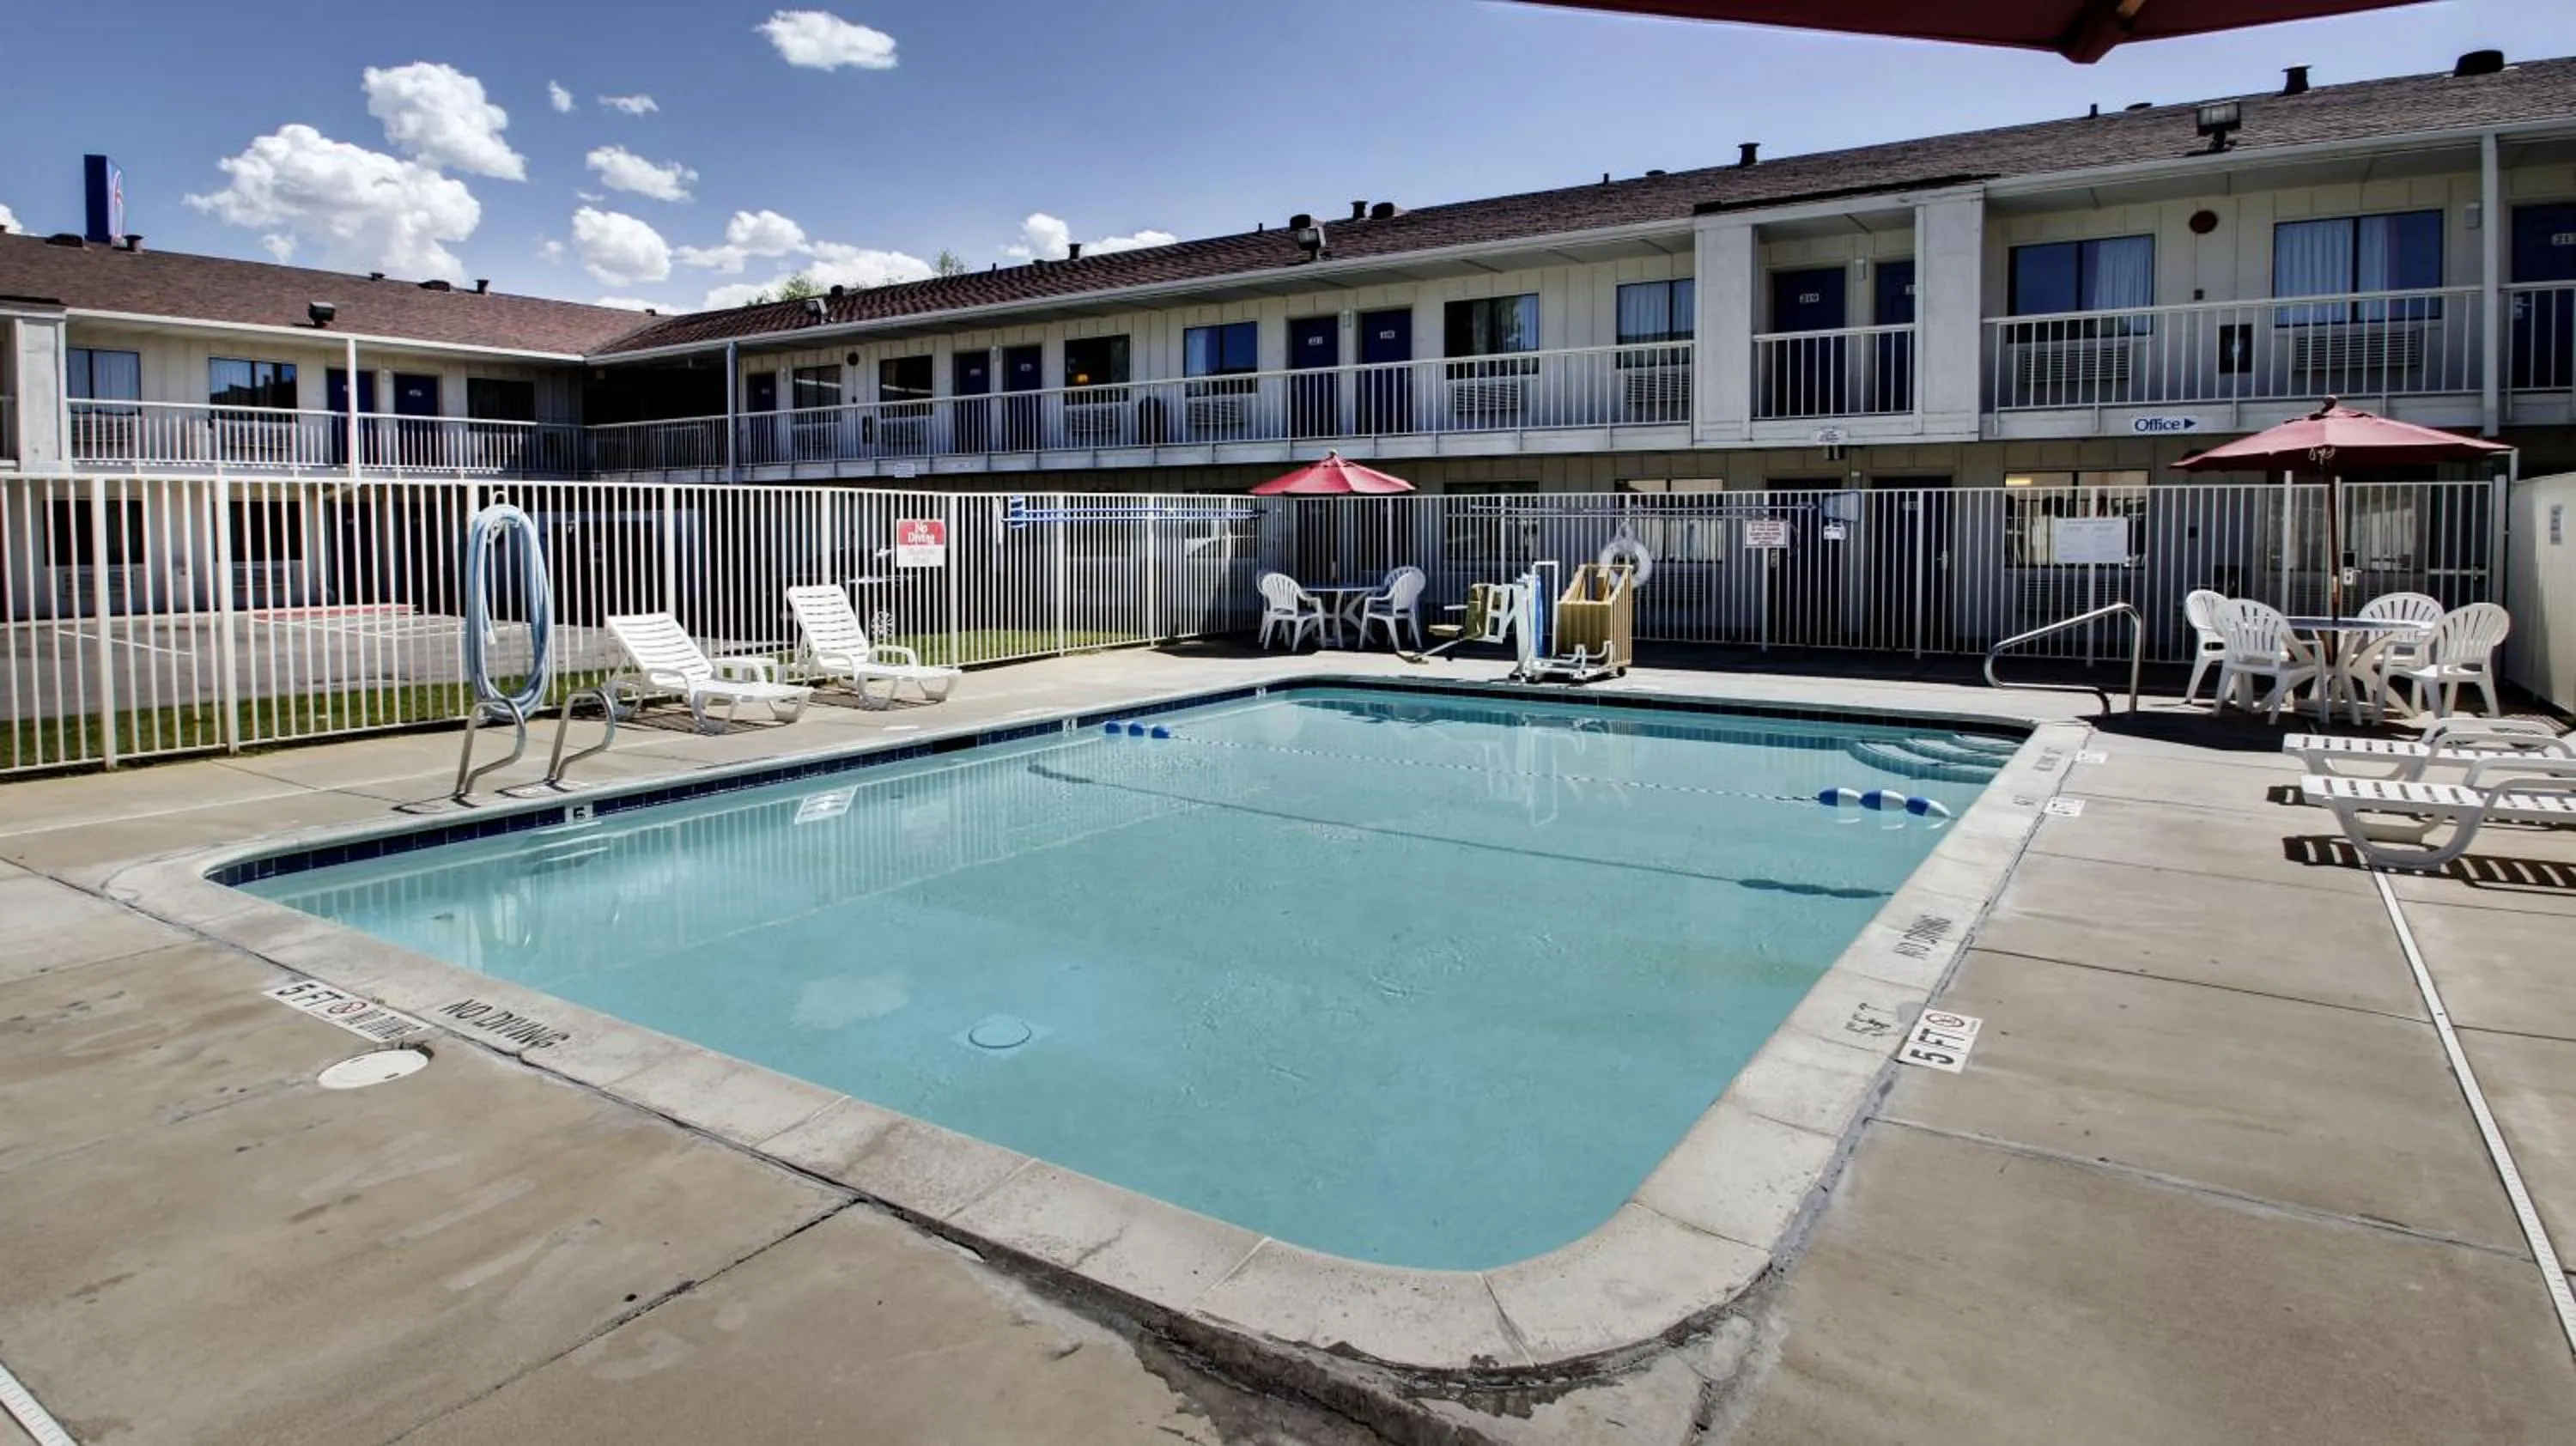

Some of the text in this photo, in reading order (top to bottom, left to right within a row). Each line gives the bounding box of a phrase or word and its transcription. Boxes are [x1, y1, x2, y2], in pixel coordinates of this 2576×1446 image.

[2135, 418, 2181, 432] Office
[914, 521, 928, 533] No
[275, 982, 344, 1007] 5 FT
[439, 999, 571, 1048] NO DIVING
[1909, 1028, 1966, 1066] 5 FT
